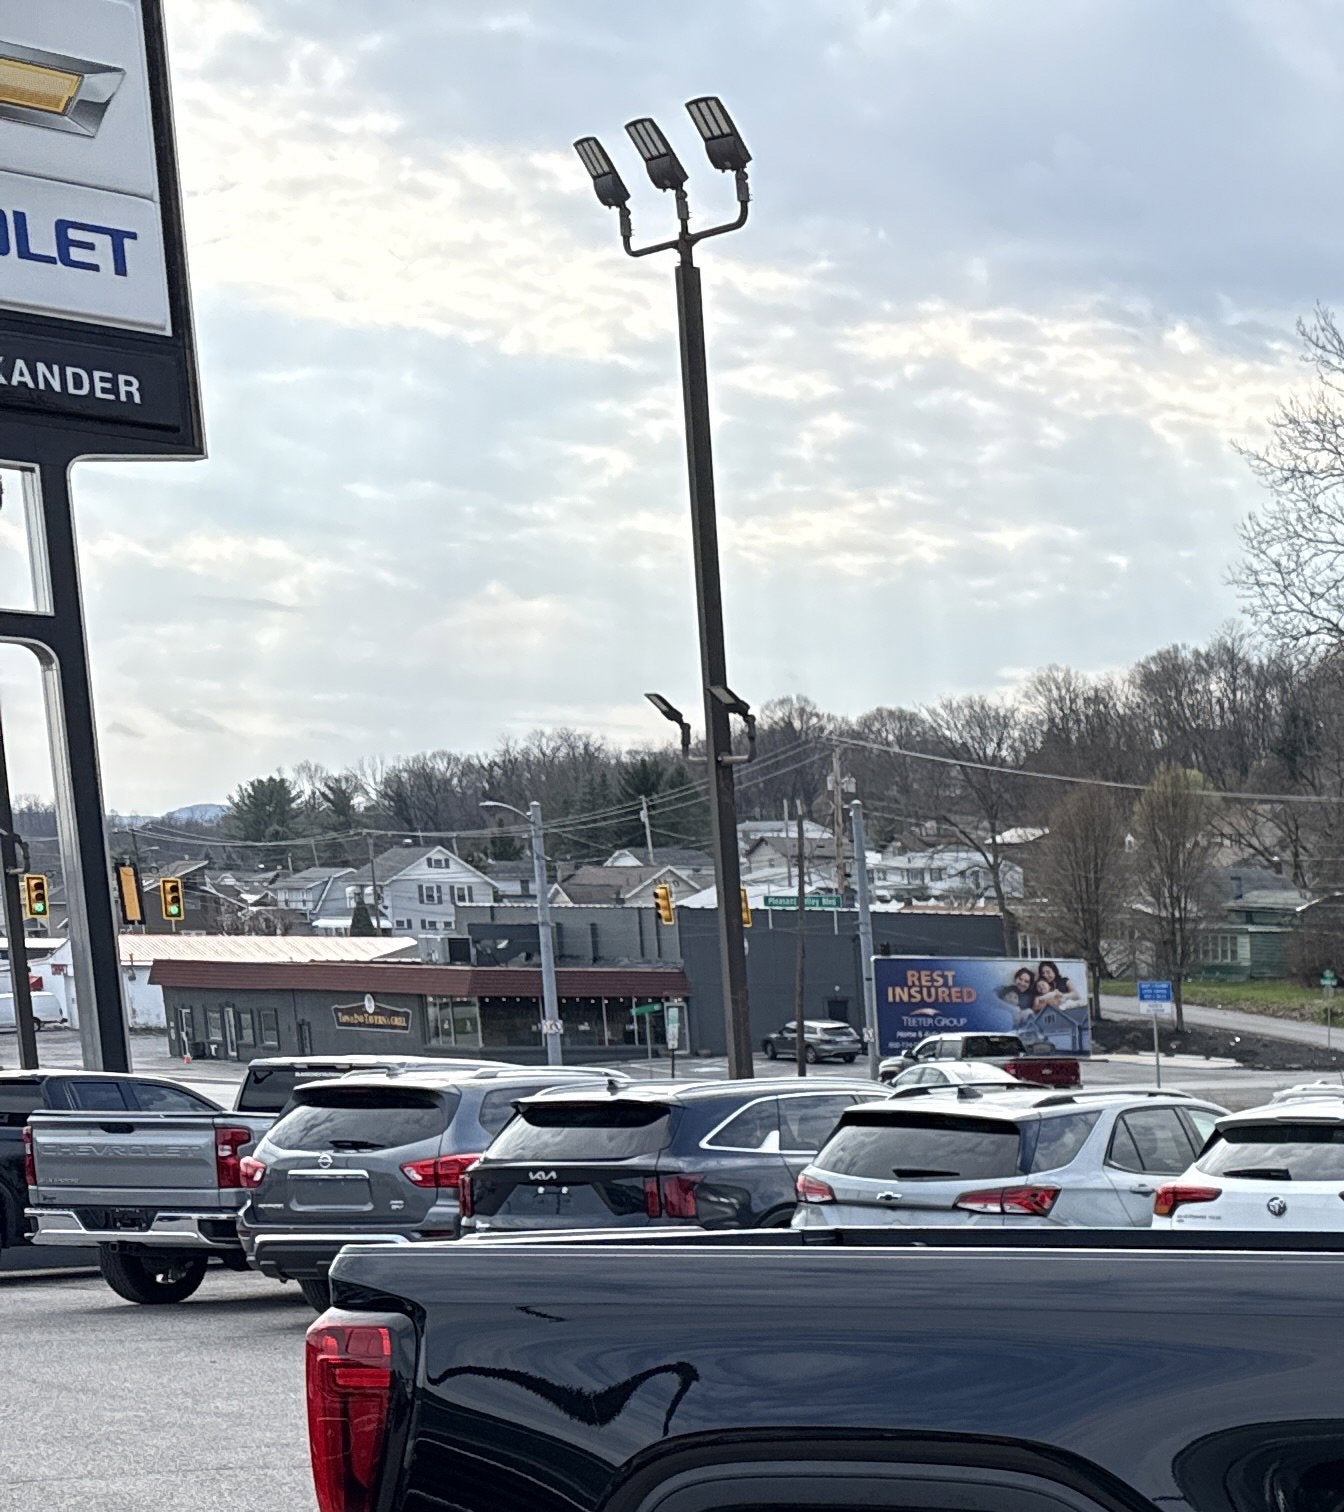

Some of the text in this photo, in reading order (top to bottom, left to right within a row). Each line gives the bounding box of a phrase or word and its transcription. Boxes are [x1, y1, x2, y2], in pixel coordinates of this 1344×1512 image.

[906, 970, 955, 987] REST
[887, 986, 977, 1003] INSURED
[934, 1017, 967, 1027] GROUP
[40, 1144, 201, 1157] CHEVROLET
